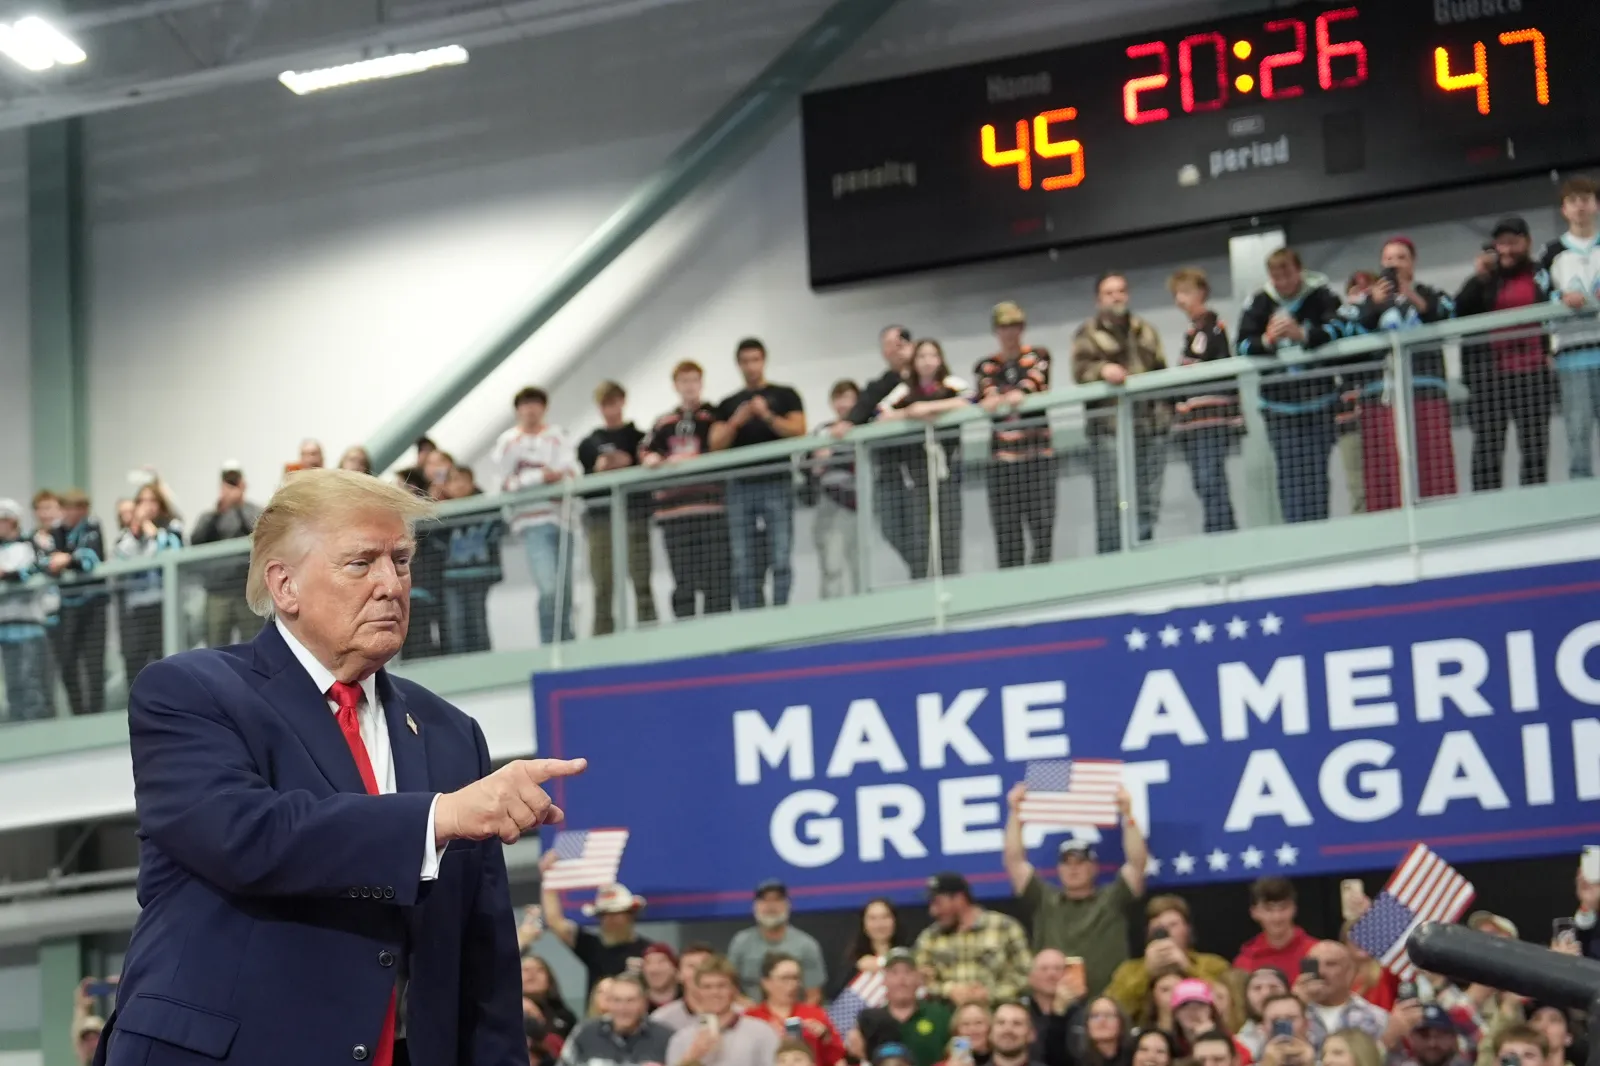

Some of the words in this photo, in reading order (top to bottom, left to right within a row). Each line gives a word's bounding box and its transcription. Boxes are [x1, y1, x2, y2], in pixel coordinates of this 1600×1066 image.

[1122, 7, 1369, 125] 20:26
[1435, 28, 1549, 115] 47
[981, 107, 1085, 191] 45
[1210, 134, 1290, 178] period
[732, 680, 1070, 786] MAKE
